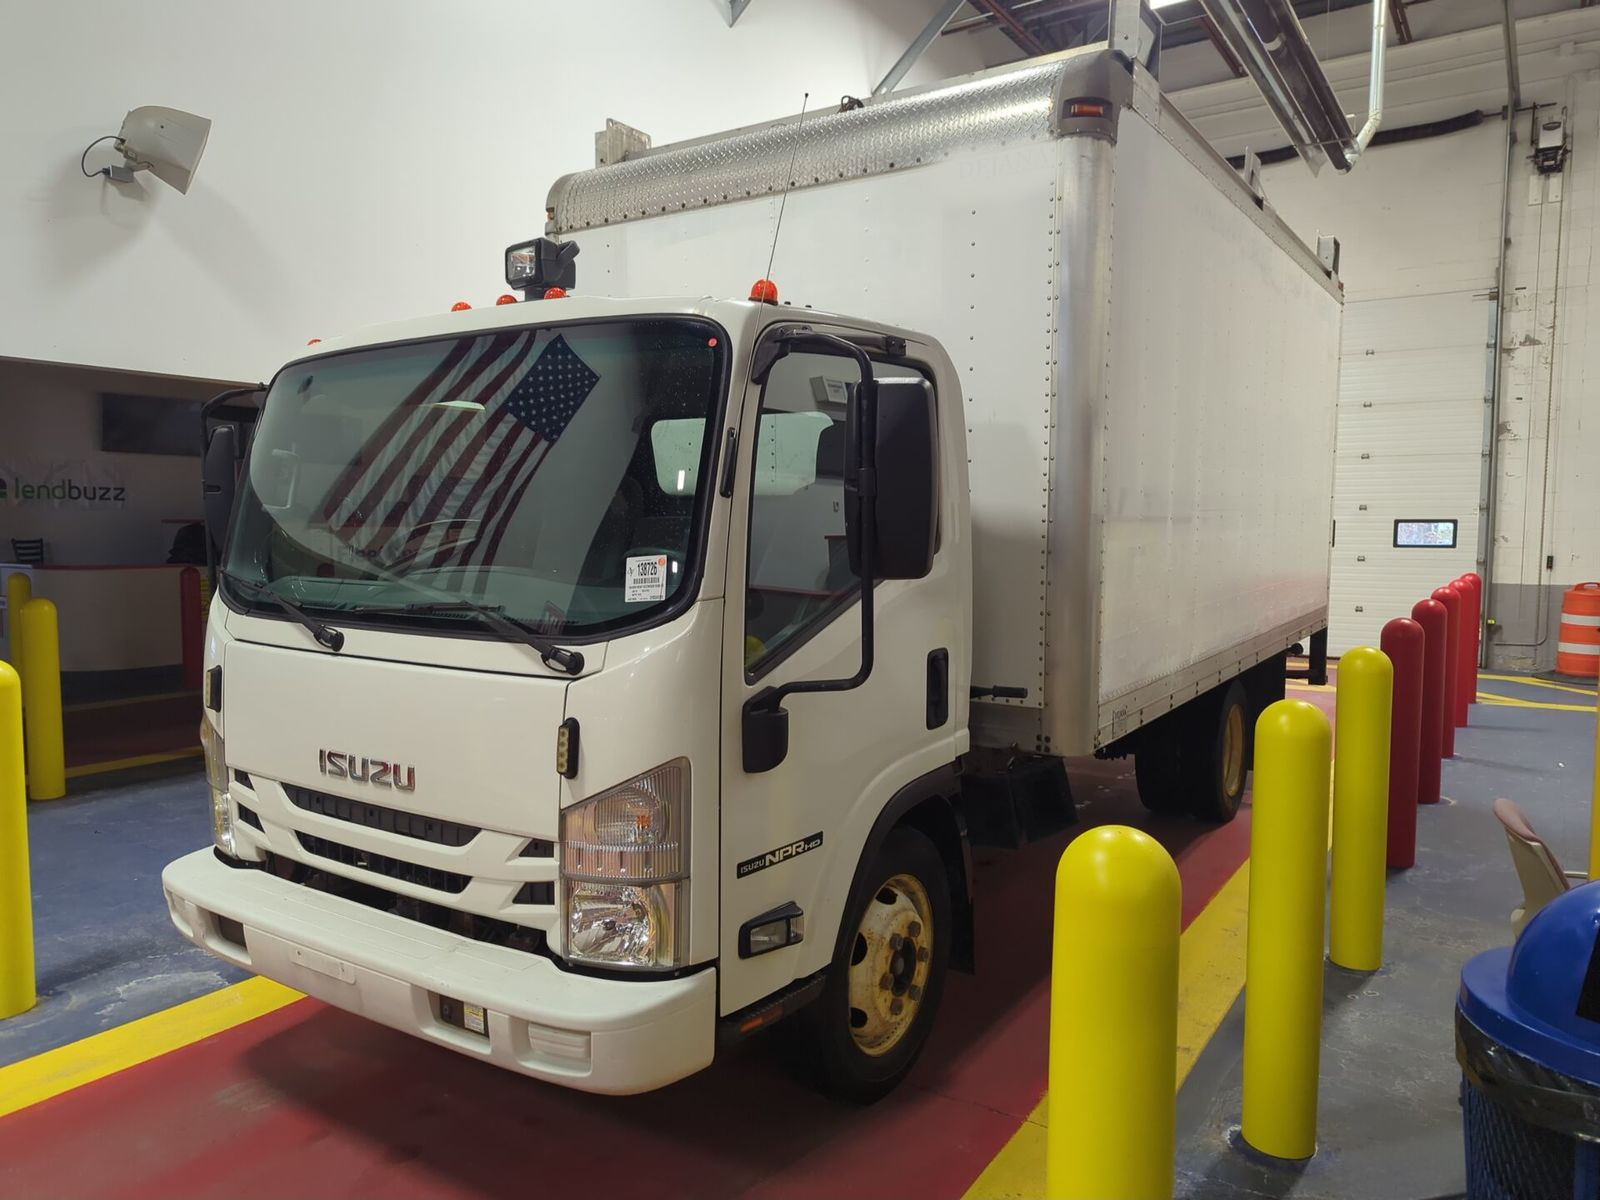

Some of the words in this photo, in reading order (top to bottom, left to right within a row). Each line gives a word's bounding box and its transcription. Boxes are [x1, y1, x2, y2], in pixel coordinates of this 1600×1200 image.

[957, 146, 1050, 180] DEJANA
[15, 477, 126, 501] lendbuzz
[637, 561, 658, 577] 138726
[319, 749, 416, 792] ISUZU
[740, 859, 765, 874] ISUZU
